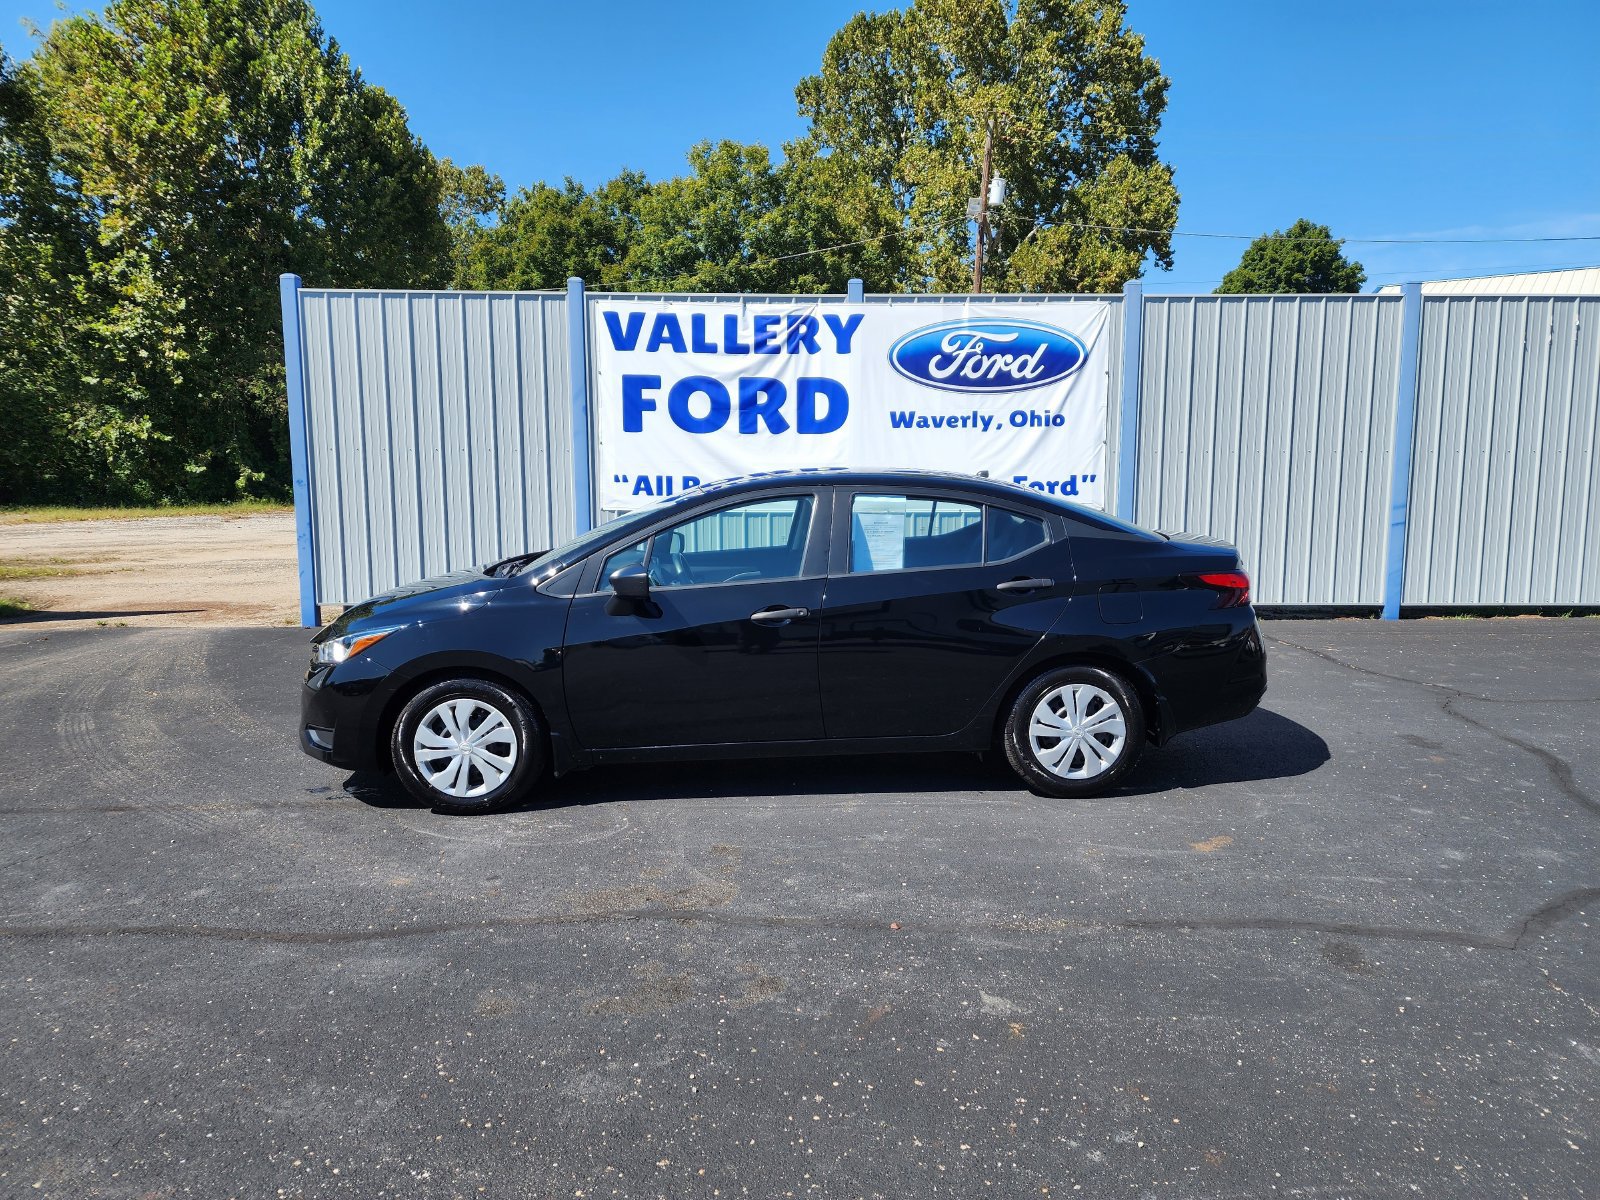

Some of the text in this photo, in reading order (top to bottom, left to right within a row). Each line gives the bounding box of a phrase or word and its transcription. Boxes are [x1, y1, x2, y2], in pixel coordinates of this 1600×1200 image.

[602, 311, 865, 355] VALLERY
[928, 329, 1049, 380] Ford
[621, 374, 850, 435] FORD
[889, 410, 1066, 432] Waverly, Ohio
